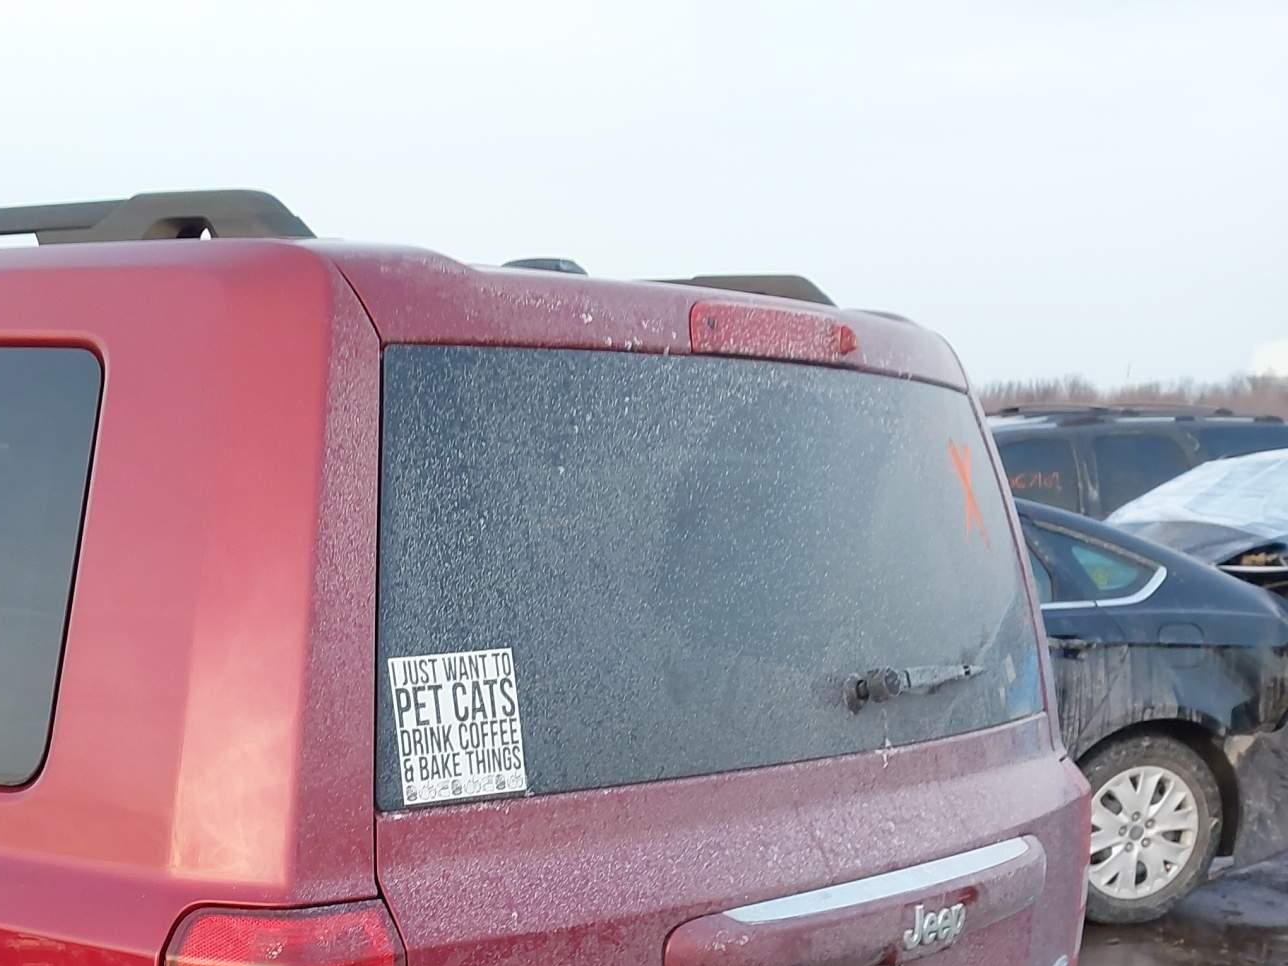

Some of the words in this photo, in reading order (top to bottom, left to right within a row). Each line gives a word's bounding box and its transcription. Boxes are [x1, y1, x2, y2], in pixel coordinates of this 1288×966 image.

[391, 662, 398, 687] I
[402, 658, 438, 686] JUST
[442, 654, 488, 682] WANT
[491, 652, 512, 678] TO
[395, 684, 443, 728] PET
[452, 677, 516, 722] CATS
[400, 725, 455, 757] DRINK
[458, 718, 520, 750] COFFEE
[403, 758, 414, 783] &
[419, 752, 462, 781] BAKE
[467, 745, 522, 775] THINGS
[903, 902, 966, 950] Jeep
